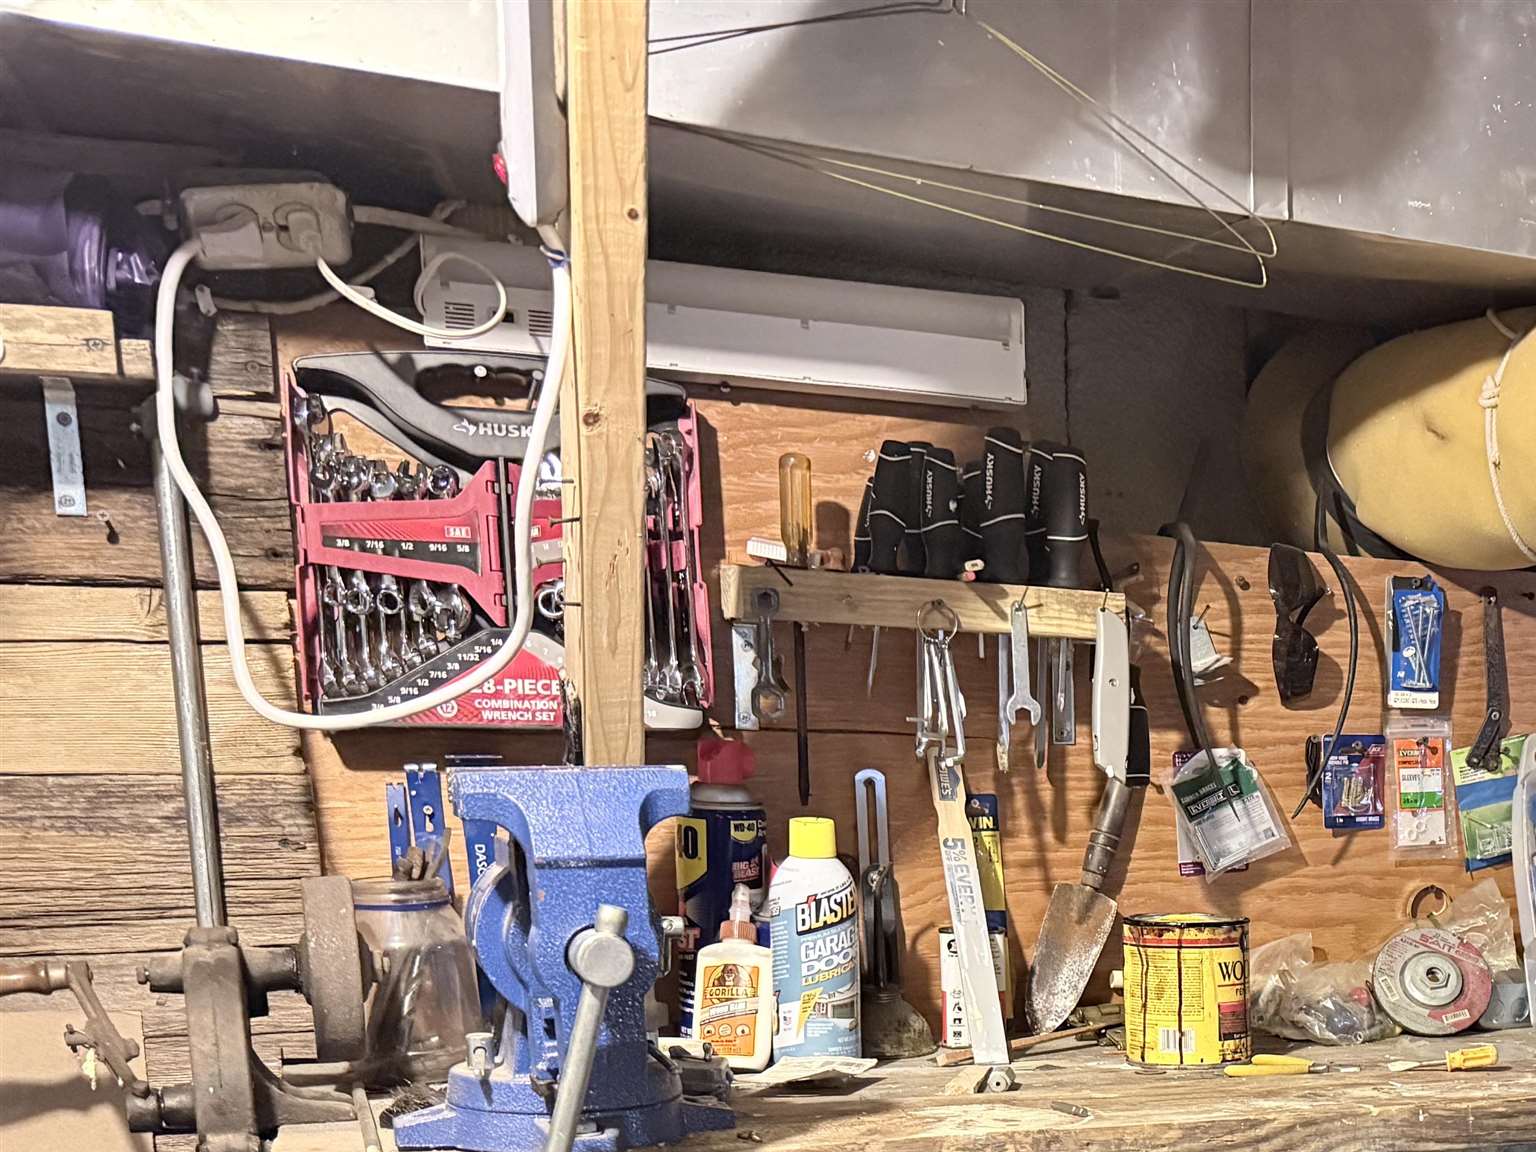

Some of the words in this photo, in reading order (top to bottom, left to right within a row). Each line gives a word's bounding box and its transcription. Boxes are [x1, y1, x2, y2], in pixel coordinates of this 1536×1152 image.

[479, 424, 536, 438] HUSK
[984, 452, 995, 494] HUSKY
[336, 538, 350, 548] 3/8
[366, 540, 384, 550] 7/16
[401, 542, 414, 550] 1/2
[490, 638, 503, 647] 1/4
[474, 645, 492, 654] 5/16
[457, 653, 480, 662] 11/32
[446, 662, 460, 671] 3/8
[429, 670, 448, 679] 7/16
[416, 678, 429, 687] 1/2
[400, 687, 419, 695] 9/16
[474, 699, 558, 710] COMBINATION
[481, 710, 533, 722] WRENCH
[535, 710, 556, 722] SET
[733, 822, 756, 832] WD-40
[800, 926, 857, 962] GARAG
[801, 947, 856, 977] DOO
[709, 987, 749, 998] GORILLA
